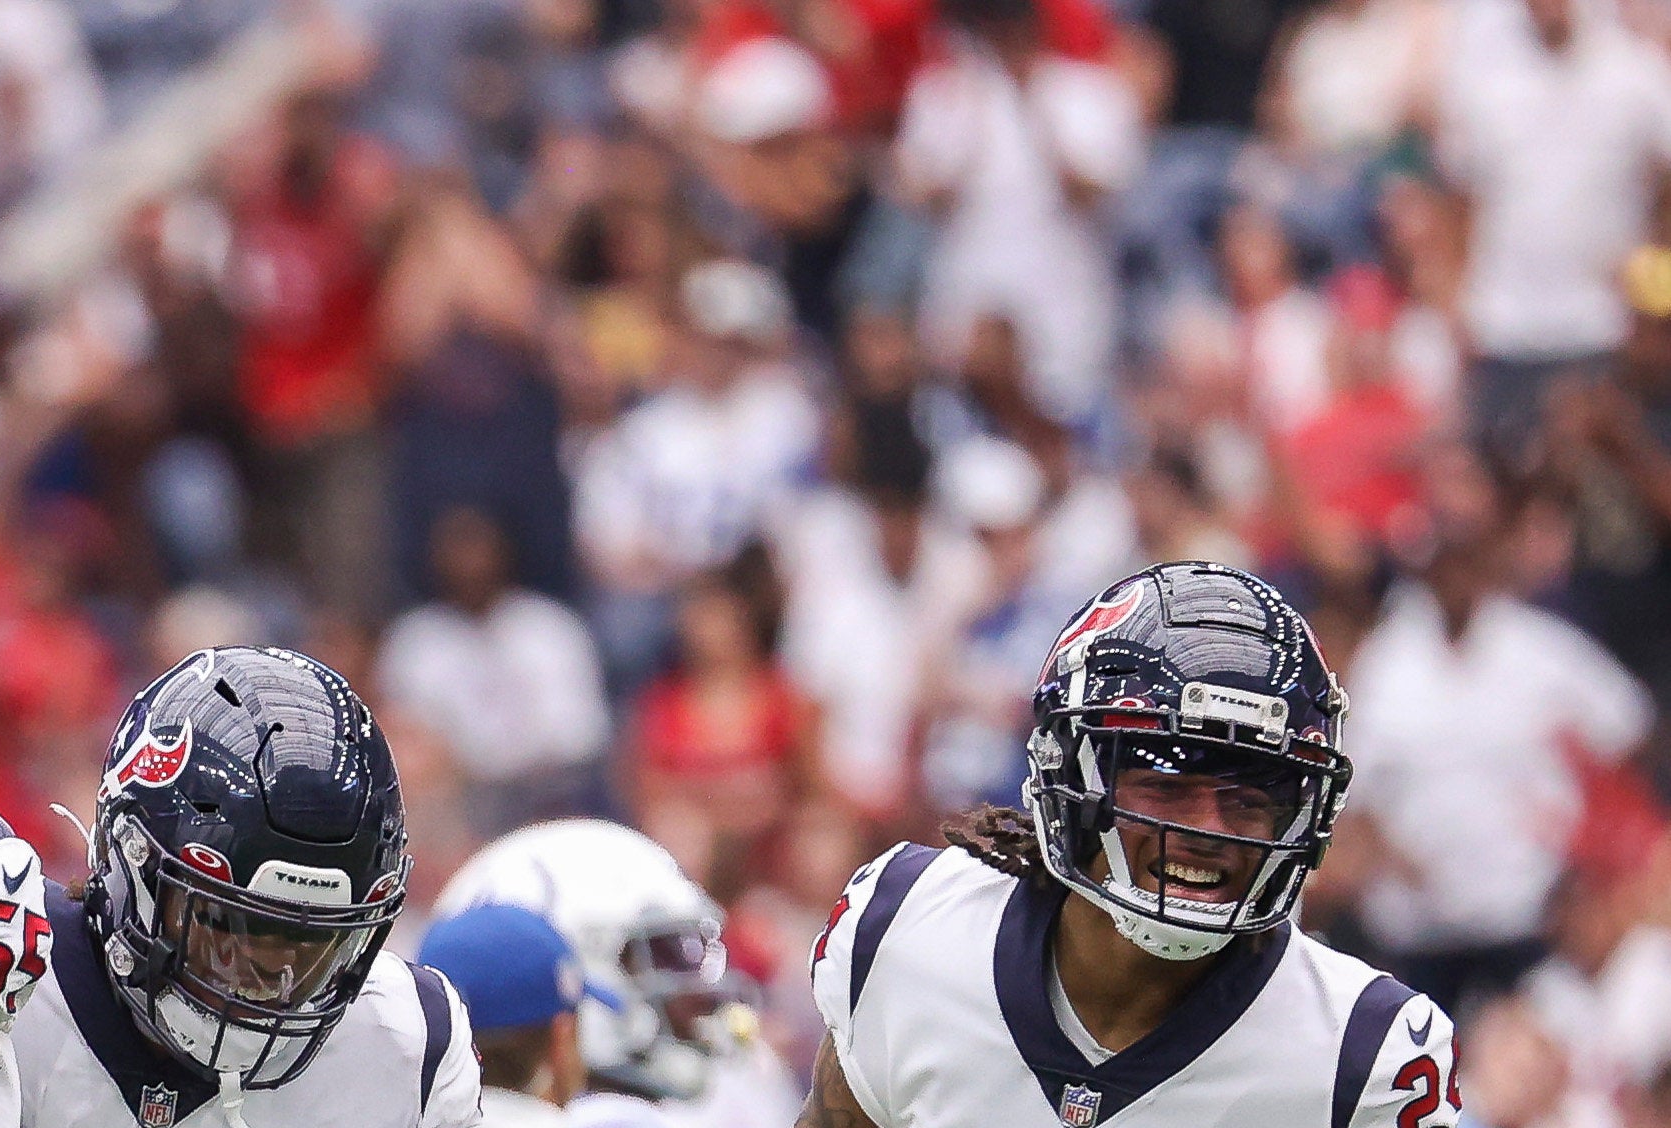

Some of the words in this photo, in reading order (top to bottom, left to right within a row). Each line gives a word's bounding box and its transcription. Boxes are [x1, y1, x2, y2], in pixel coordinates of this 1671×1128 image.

[275, 871, 341, 890] TEXANS
[144, 1103, 170, 1125] NFL
[1064, 1103, 1093, 1126] NFL
